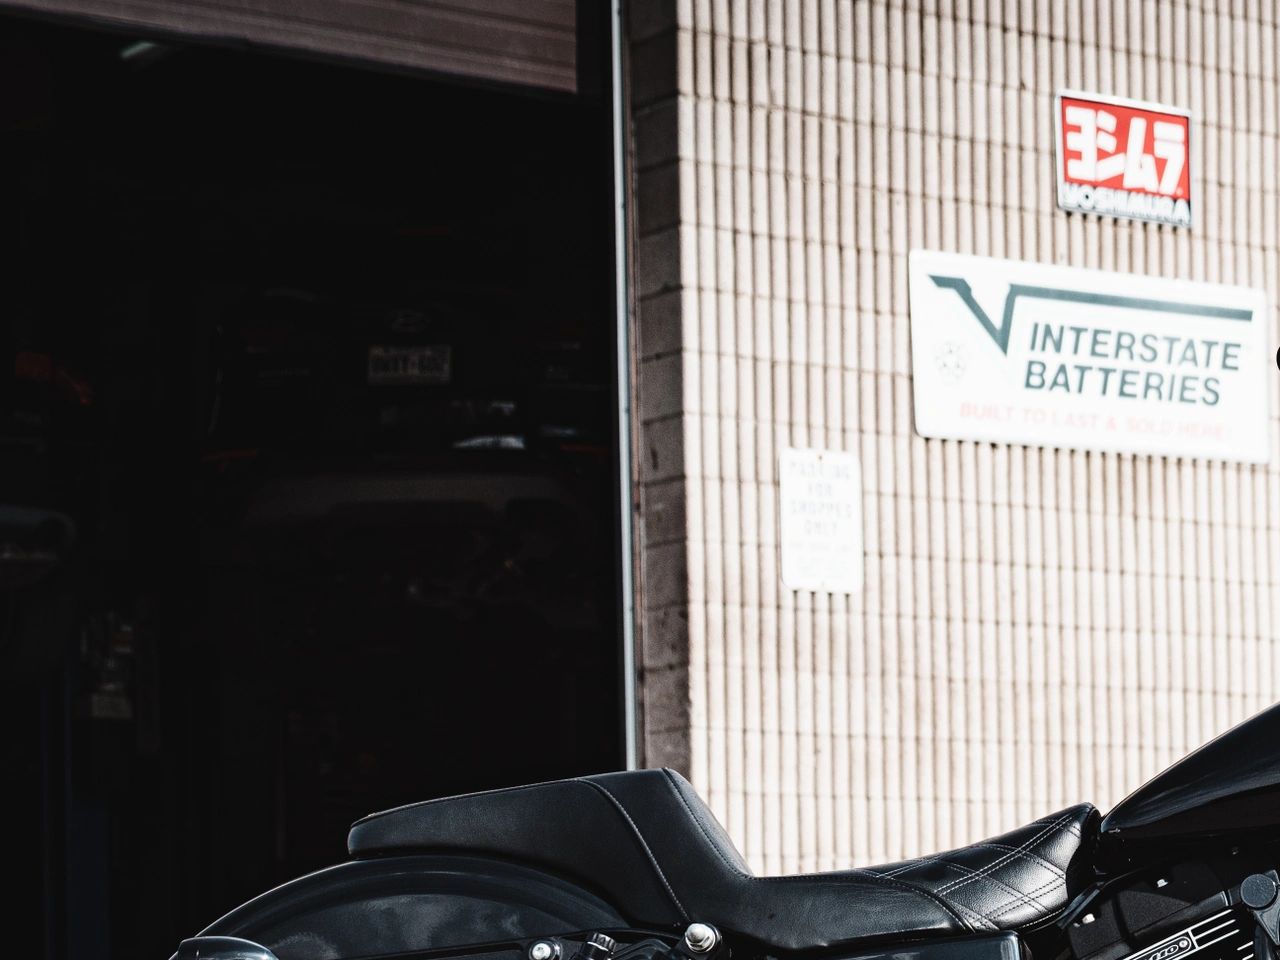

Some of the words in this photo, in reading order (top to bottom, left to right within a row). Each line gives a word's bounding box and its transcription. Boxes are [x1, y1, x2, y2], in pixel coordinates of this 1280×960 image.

[1065, 106, 1185, 195] ヨシムラ
[1030, 322, 1242, 371] INTERSTATE
[1024, 360, 1221, 407] BATTERIES
